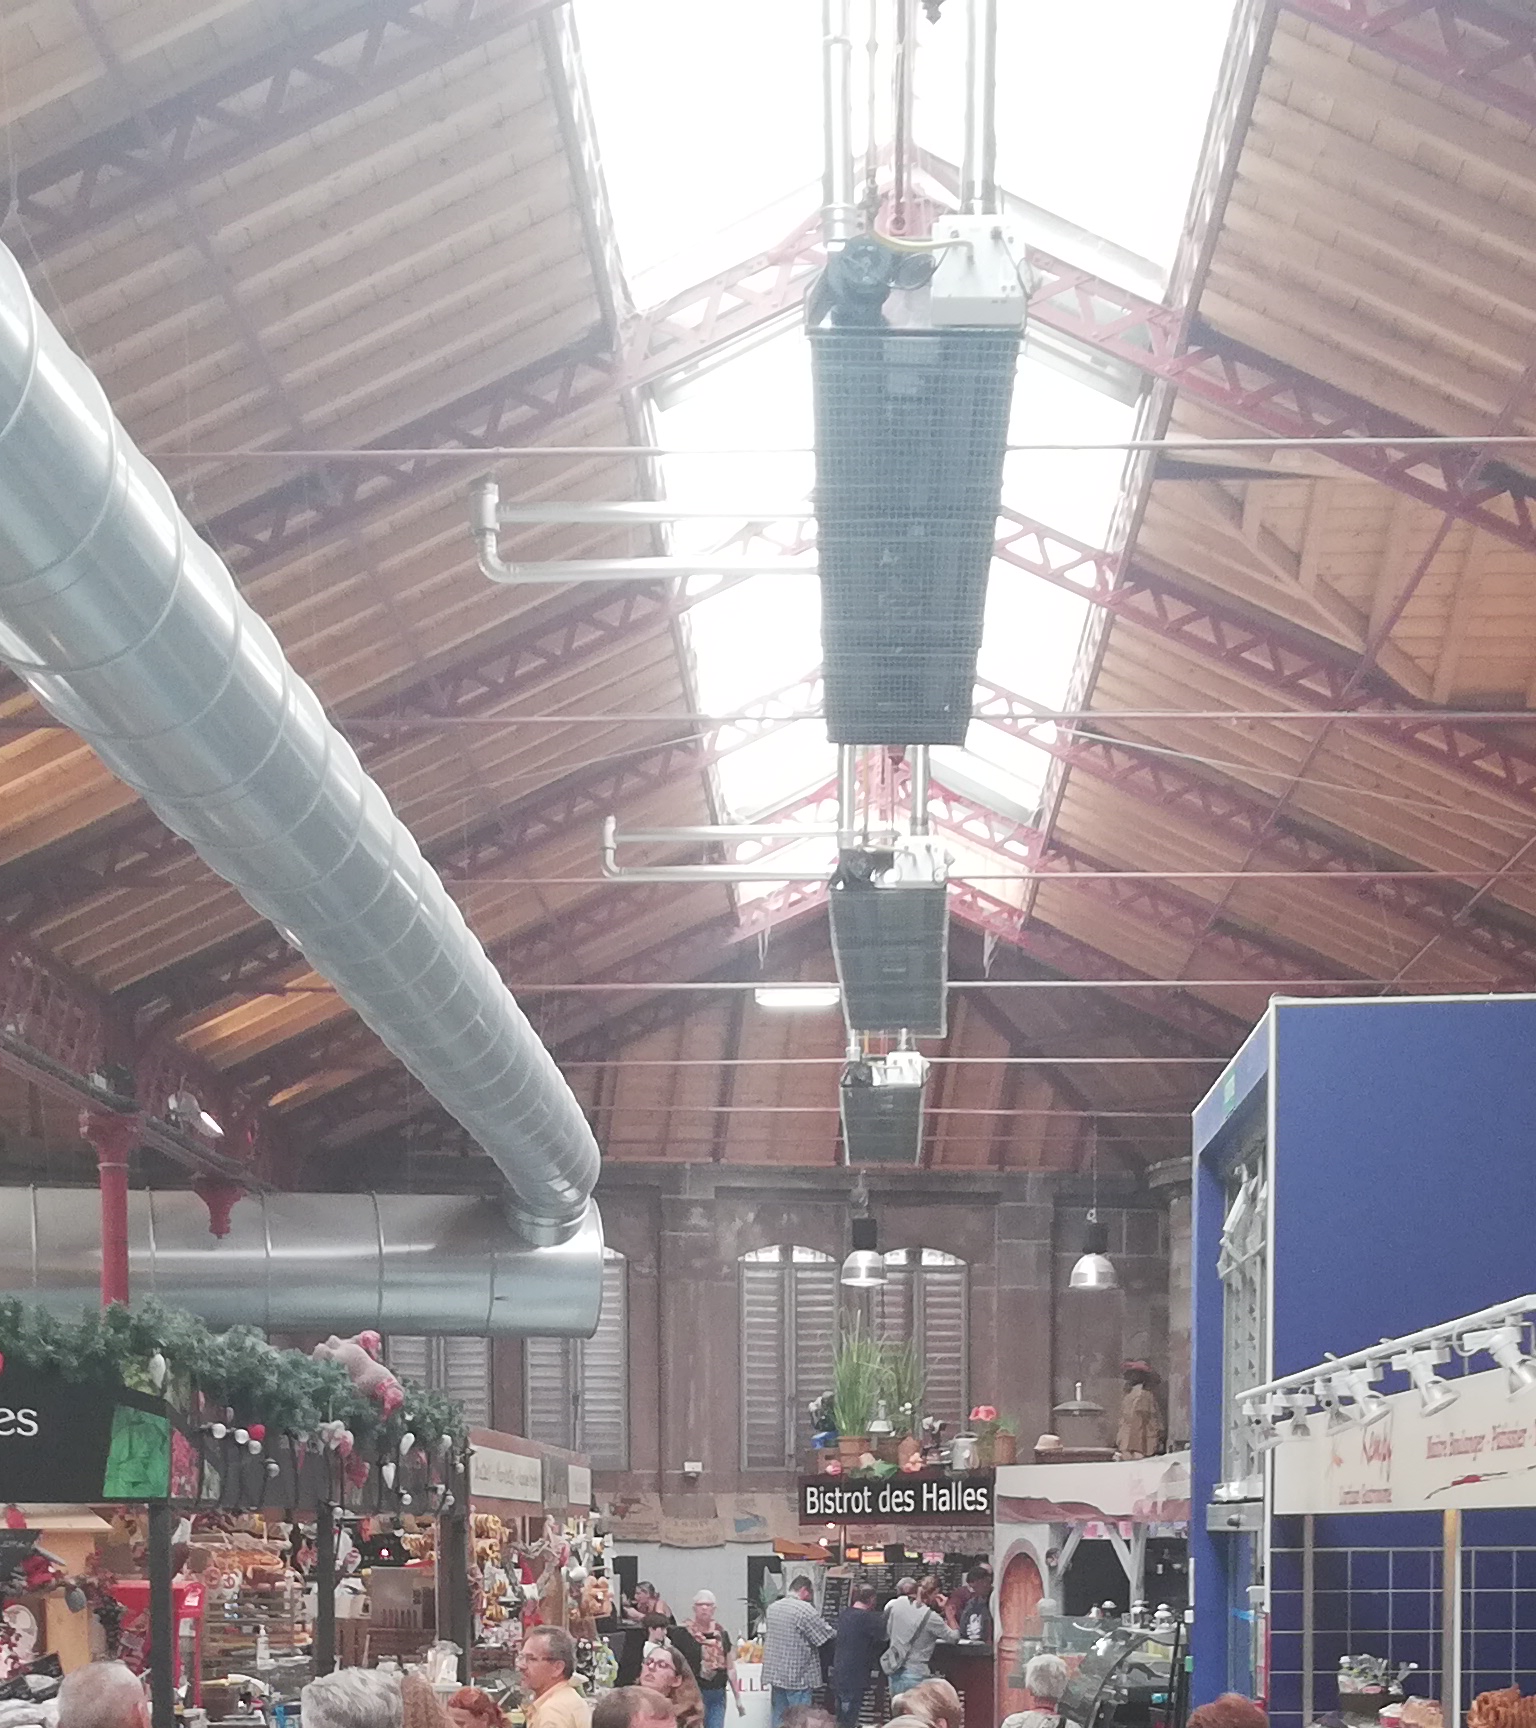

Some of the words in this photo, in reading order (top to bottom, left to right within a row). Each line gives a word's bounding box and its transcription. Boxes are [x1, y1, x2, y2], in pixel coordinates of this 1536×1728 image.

[806, 1486, 872, 1514] Bistrot
[878, 1483, 914, 1512] des
[922, 1480, 989, 1512] Halles
